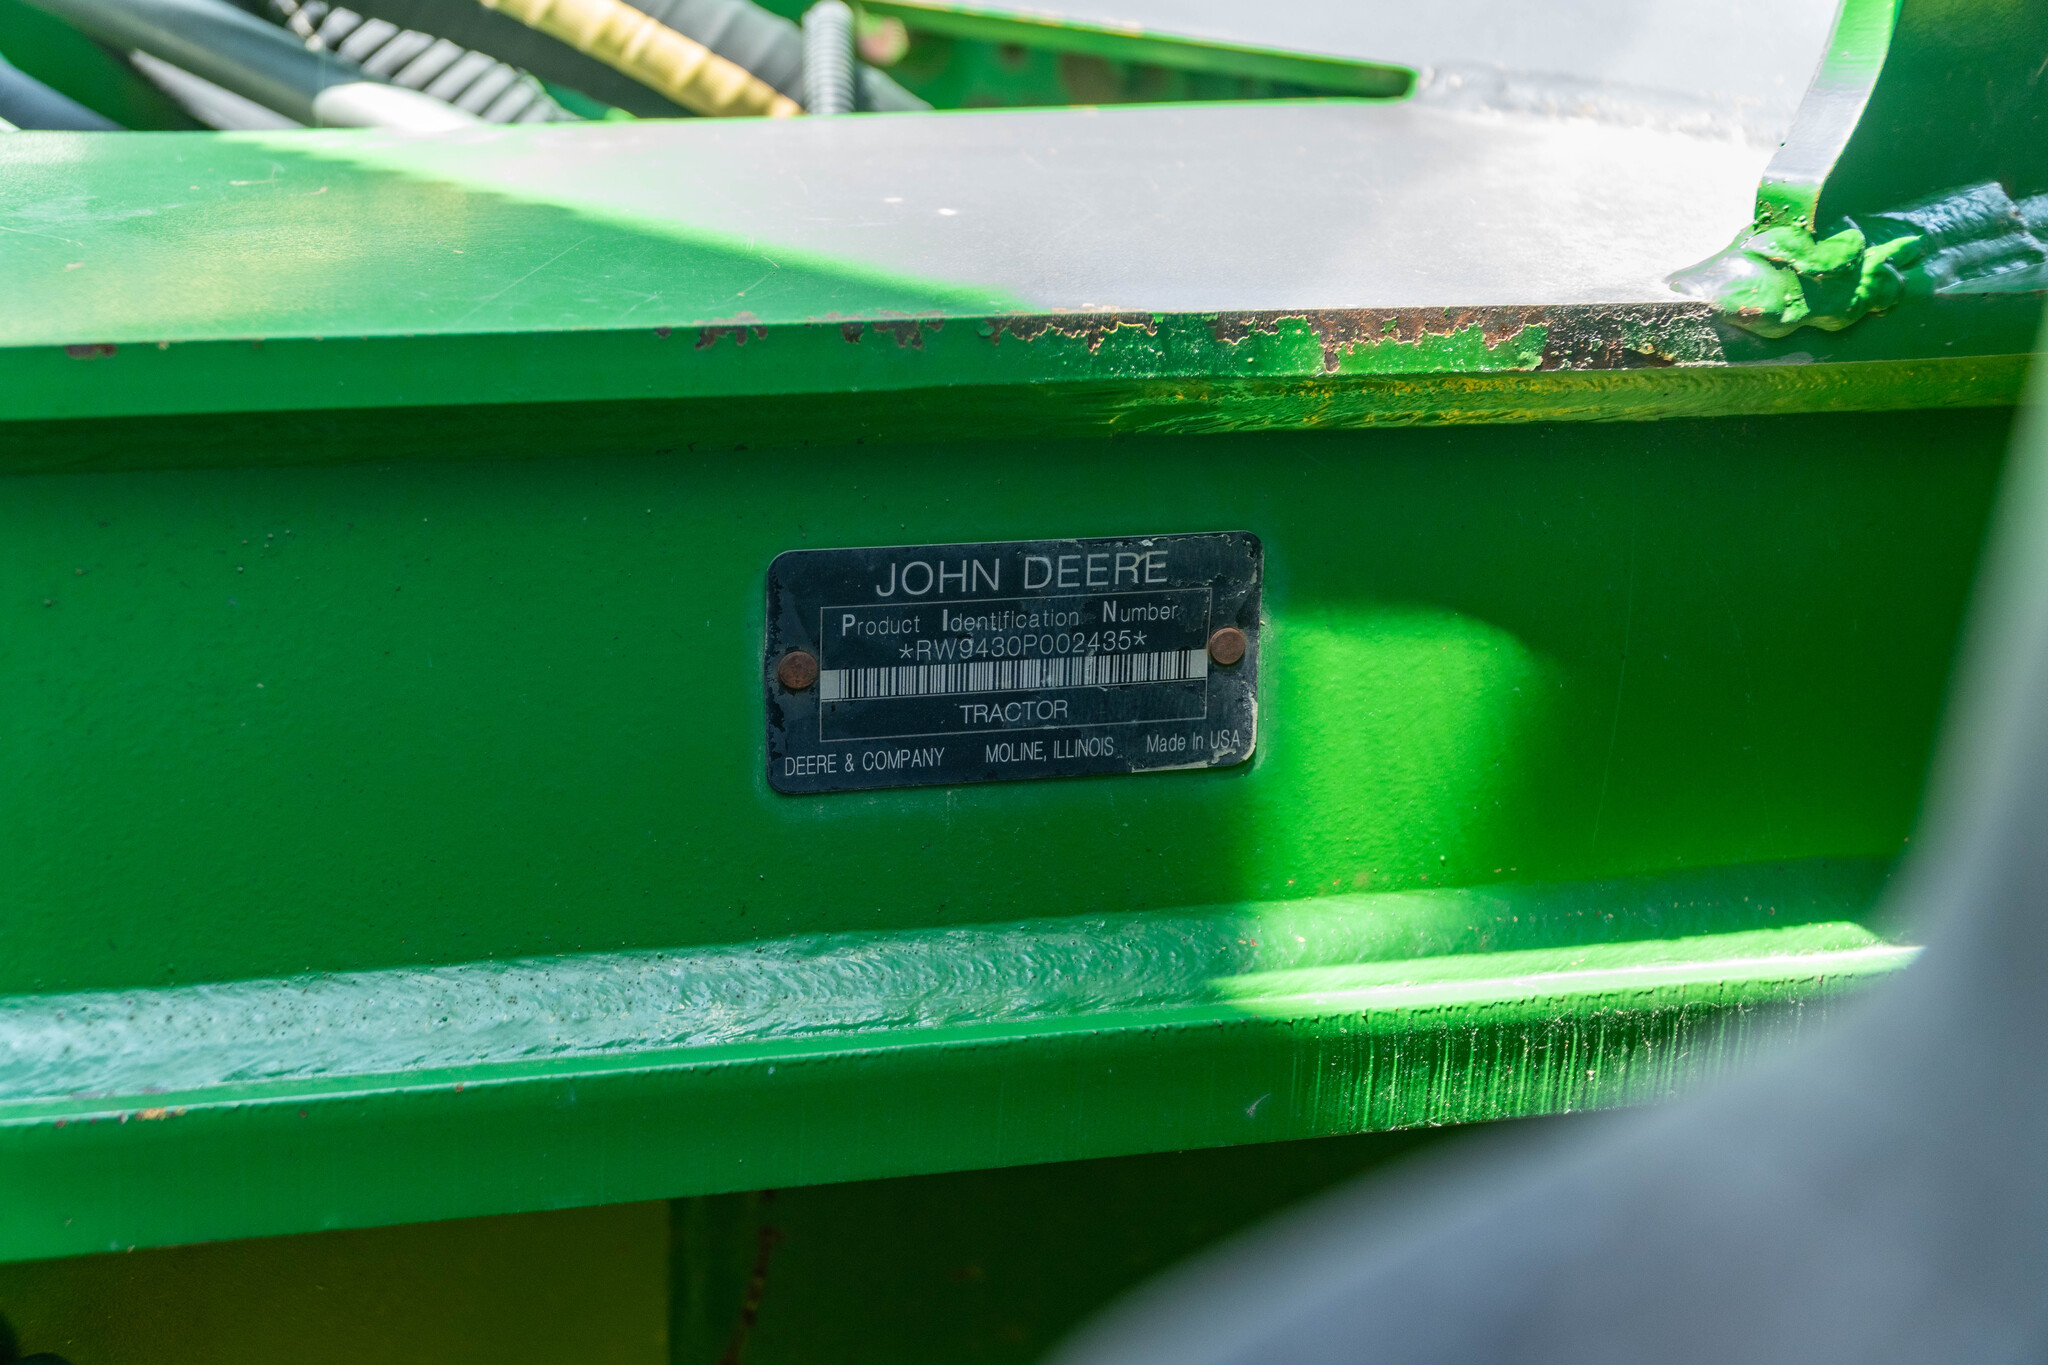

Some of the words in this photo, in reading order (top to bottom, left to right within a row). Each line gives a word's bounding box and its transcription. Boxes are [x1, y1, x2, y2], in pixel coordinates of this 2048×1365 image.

[876, 558, 1000, 597] JOHN
[1024, 550, 1168, 589] DEERE
[842, 613, 920, 636] Product
[942, 609, 1079, 632] Identification
[1103, 600, 1178, 623] Number
[959, 700, 1068, 724] TRACTOR
[986, 741, 1047, 763] MOLINE,
[1053, 736, 1114, 759] ILLINOIS
[1147, 733, 1186, 753] Made
[1210, 729, 1241, 749] USA
[785, 754, 837, 776] DEERE
[844, 753, 854, 772] &
[862, 748, 945, 771] COMPANY
